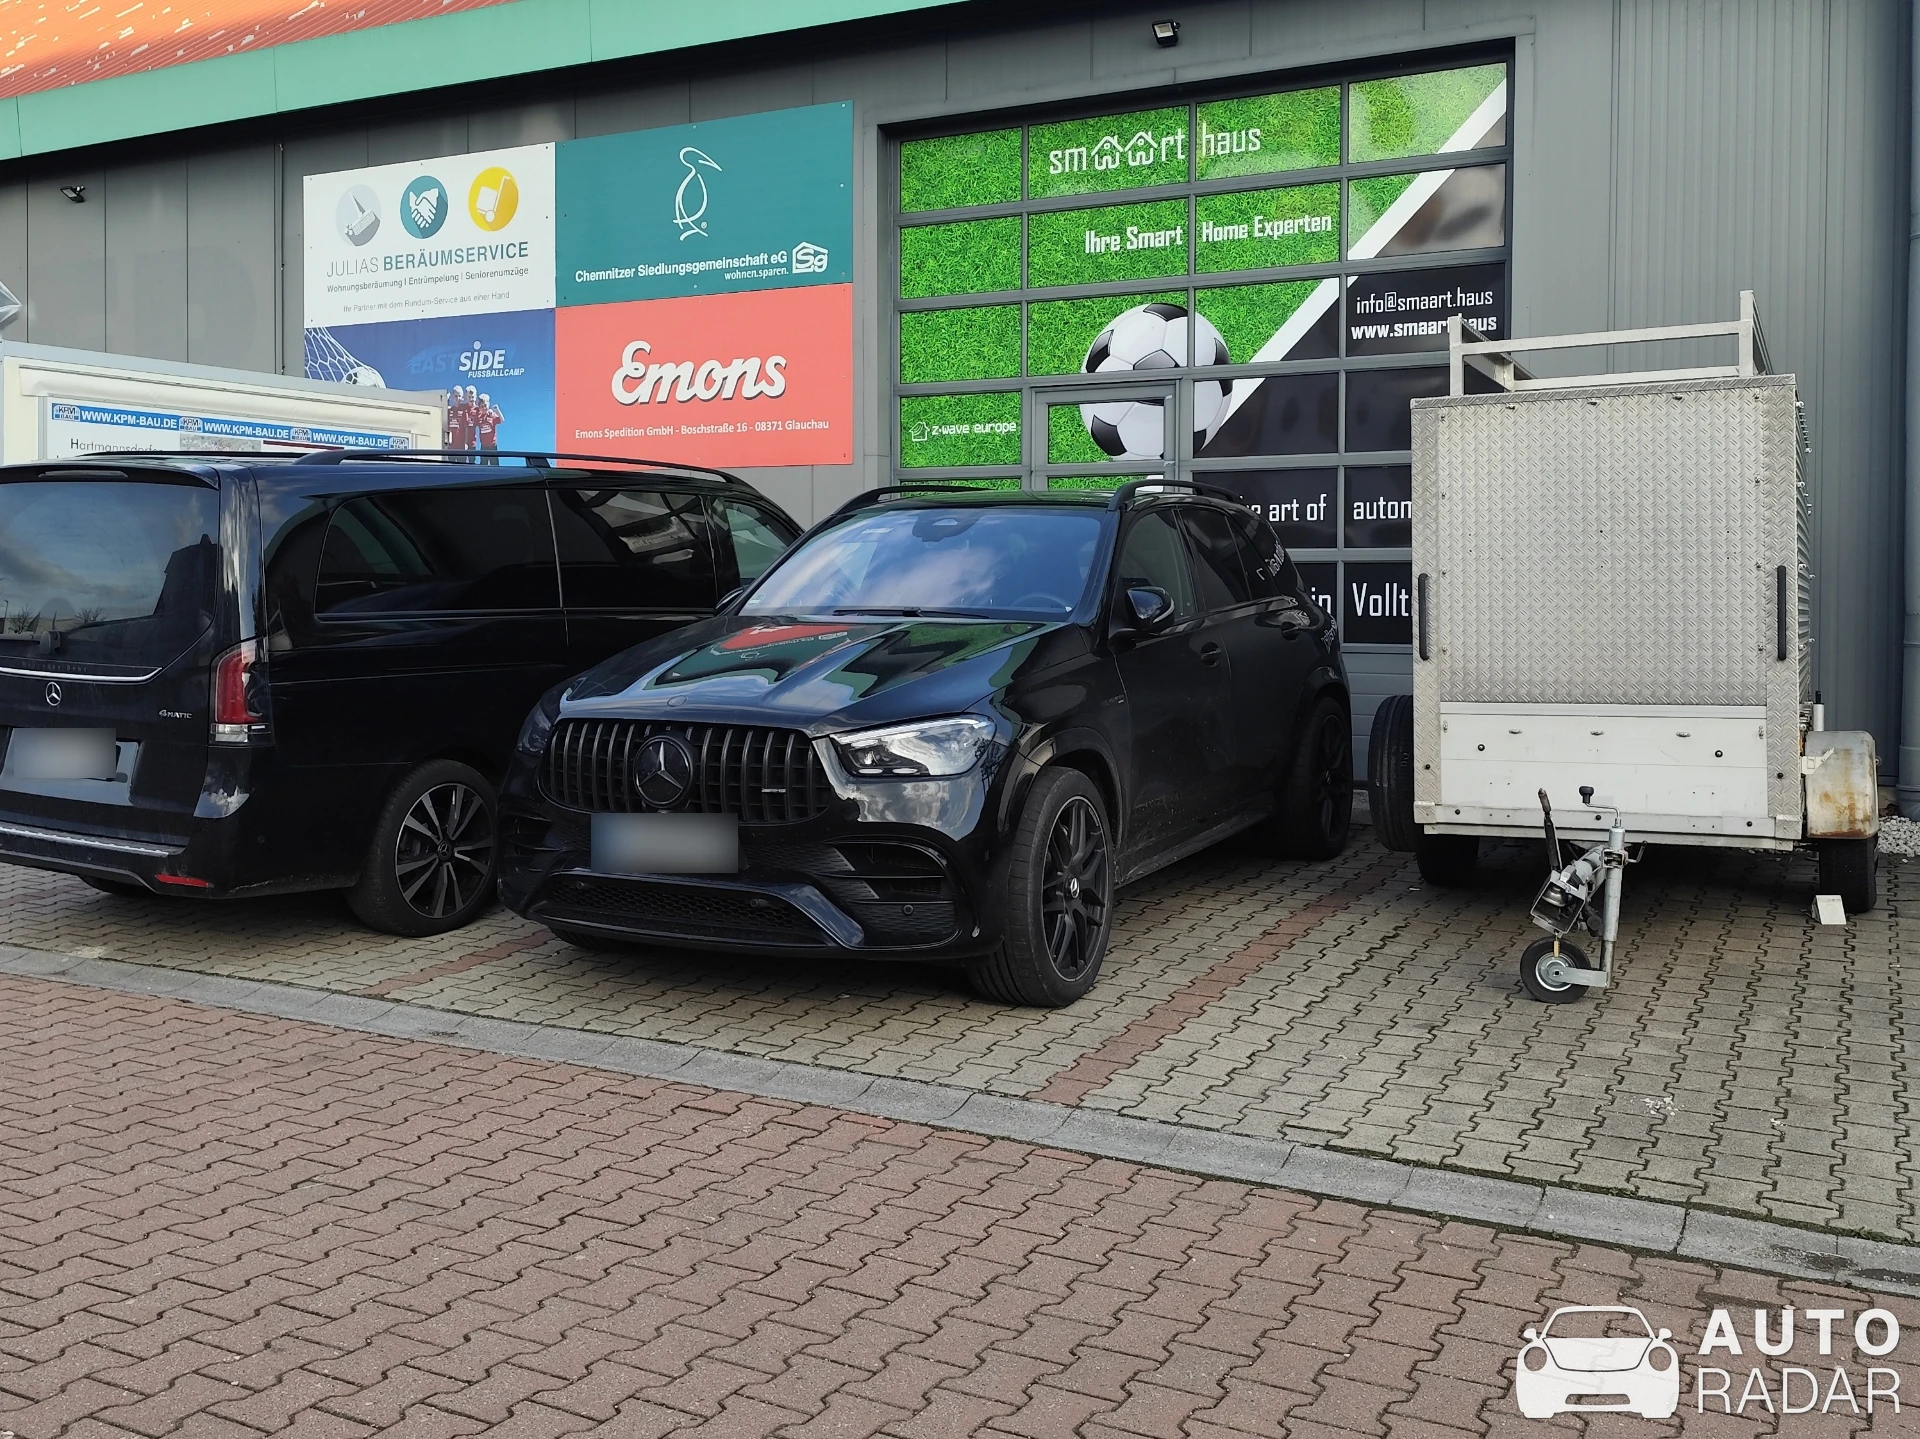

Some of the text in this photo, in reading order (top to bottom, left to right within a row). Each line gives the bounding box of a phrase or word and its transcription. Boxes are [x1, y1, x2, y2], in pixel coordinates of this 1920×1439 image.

[1202, 122, 1261, 156] haus
[1085, 214, 1332, 254] Ihre Smart Home Experten
[327, 241, 529, 277] JULIAS BERÄUMSERVICE
[575, 250, 788, 282] Chemnitzer Siedlungsgemeinschaft eG
[327, 280, 403, 292] Wohnungsberäumung
[408, 274, 459, 286] Entrümpelung
[465, 267, 529, 280] Seniorenumzüge
[343, 305, 352, 313] Ihr
[353, 303, 376, 312] Partner
[389, 301, 403, 309] dem
[404, 296, 458, 307] Rundum-Service
[460, 295, 472, 303] aus
[473, 293, 490, 301] einer
[491, 291, 510, 300] Hand
[1356, 286, 1493, 314] info@smaart.haus
[467, 367, 525, 379] FUSSBALLCAMP
[611, 340, 787, 406] Emons
[58, 405, 76, 414] KPM
[81, 410, 178, 429] WWW.KPM-BAU.DE
[204, 422, 289, 439] WWW.KPM-BAU.DE
[312, 433, 388, 448] WWW.KPM-BAU.DE
[575, 428, 603, 439] Emons
[604, 426, 645, 439] Spedition
[646, 425, 674, 437] GmbH
[681, 423, 734, 435] Boschstraße
[736, 423, 748, 433] 16
[755, 421, 783, 432] 08371
[785, 418, 829, 431] Glauchau
[973, 421, 1017, 434] europe
[1268, 498, 1300, 522] art
[1306, 493, 1327, 521] of
[159, 709, 193, 719] 4MATIC
